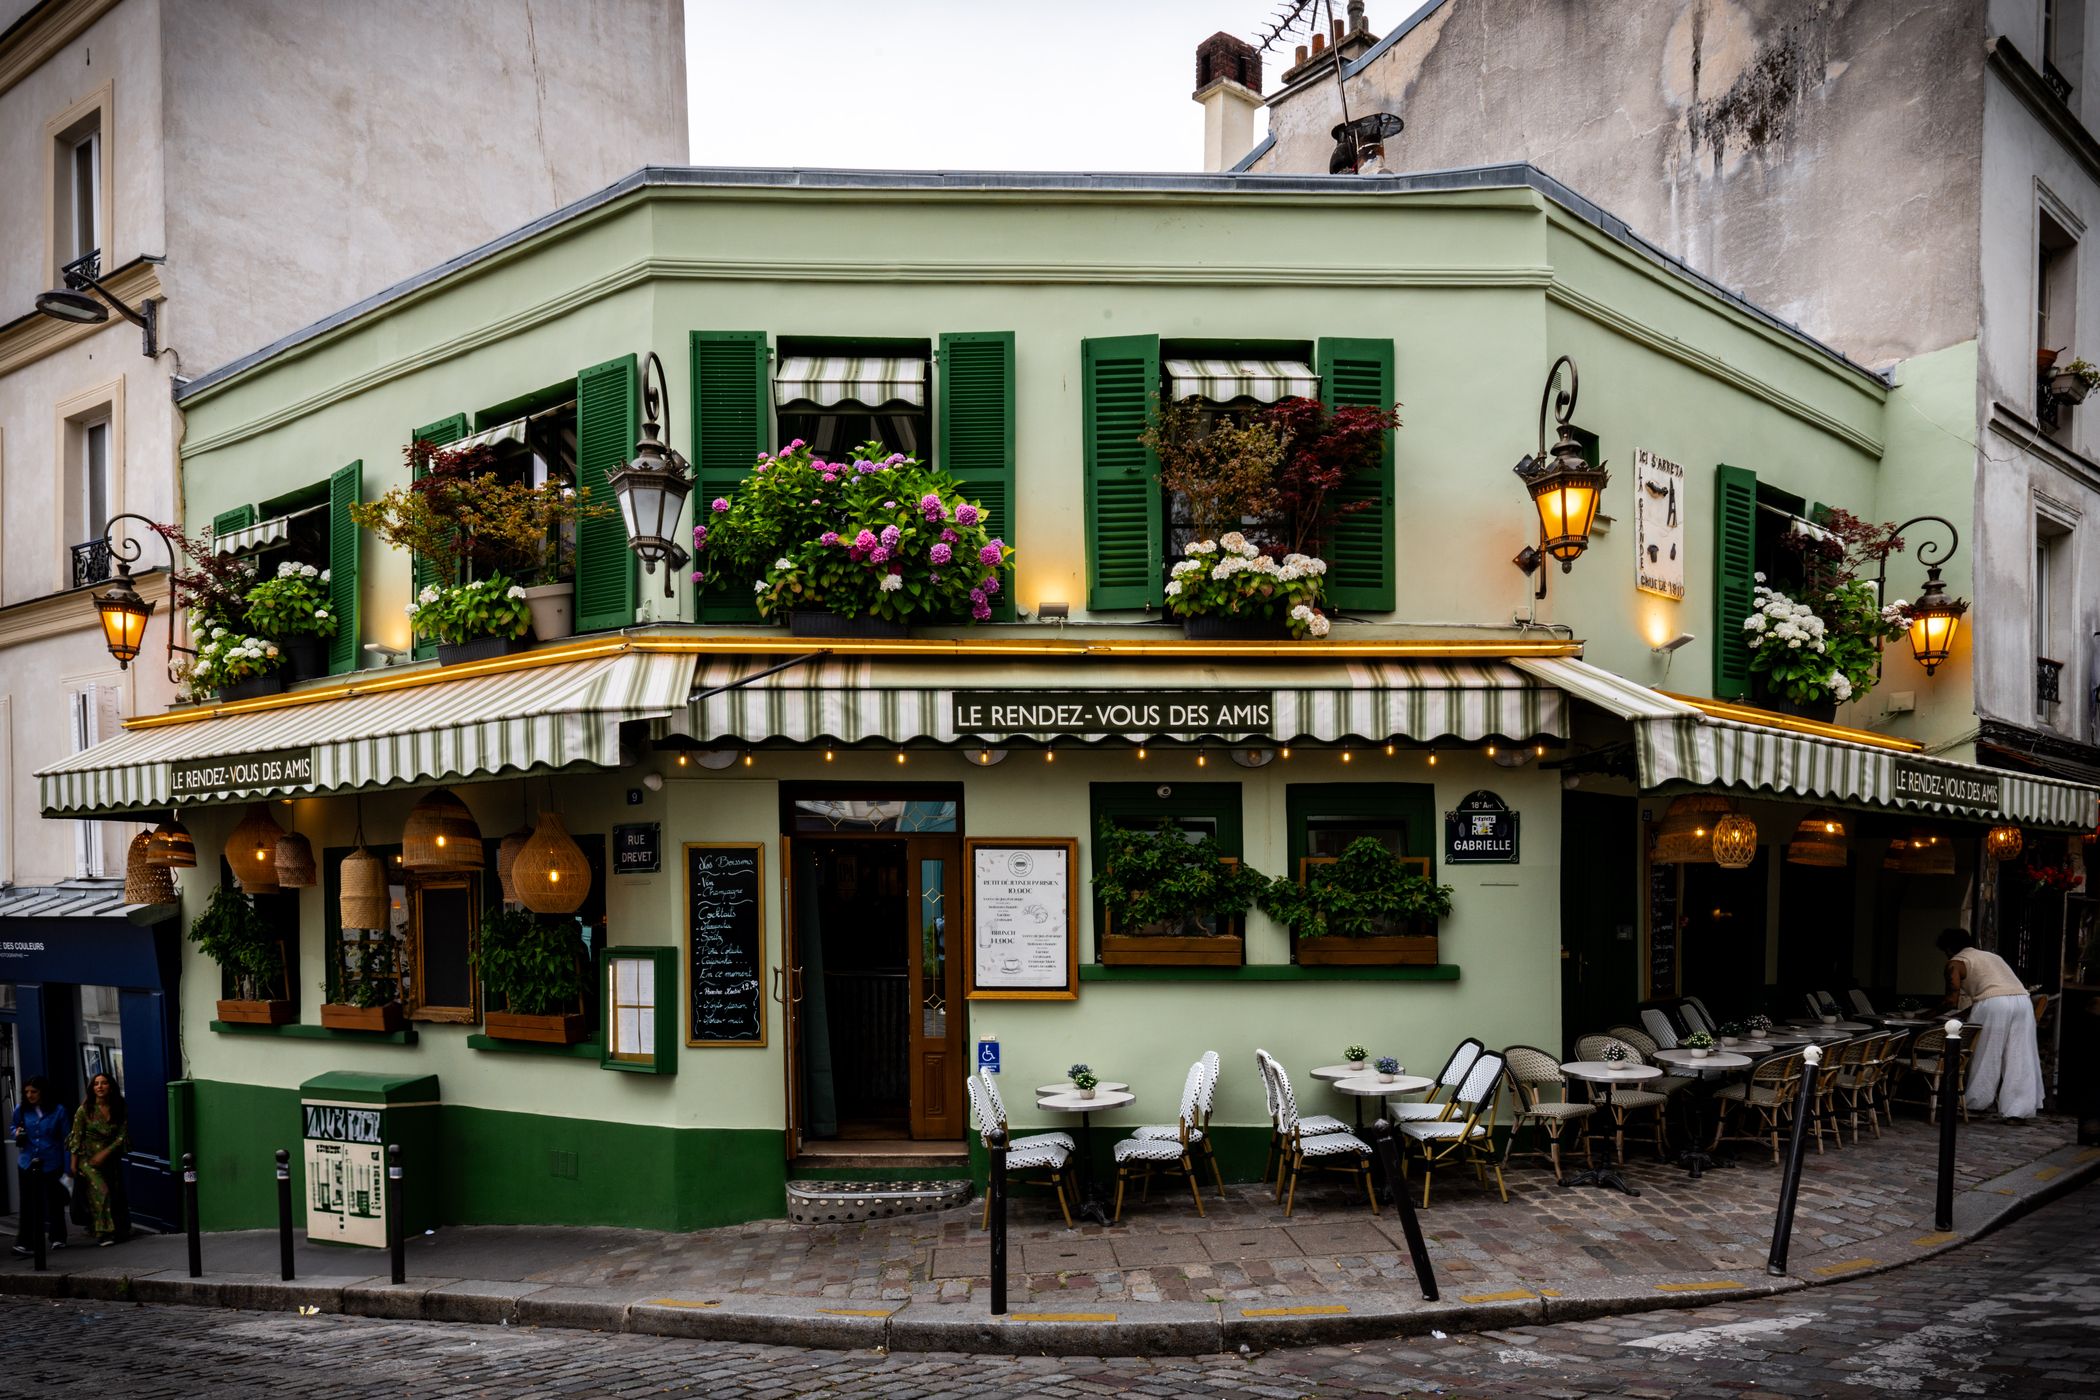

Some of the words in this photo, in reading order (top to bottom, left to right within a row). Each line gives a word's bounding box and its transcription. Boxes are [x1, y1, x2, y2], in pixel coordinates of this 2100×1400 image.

[1639, 449, 1648, 465] ICI
[1659, 580, 1667, 592] DE
[1669, 582, 1685, 599] 1910
[957, 705, 983, 727] LE
[991, 705, 1161, 727] RENDEZ-VOUS
[1169, 705, 1210, 726] DES
[1216, 704, 1270, 726] AMIS
[172, 771, 184, 790] LE
[186, 763, 260, 789] RENDEZ-VOUS
[262, 761, 282, 781] DES
[284, 757, 311, 780] AMIS
[1896, 769, 1907, 791] LE
[1908, 771, 1966, 799] RENDEZ-VOUS
[1967, 781, 1981, 801] DES
[1981, 784, 1999, 804] AMIS
[631, 792, 638, 802] 9
[1471, 824, 1494, 836] RE
[627, 834, 646, 846] RUE
[1453, 840, 1512, 851] GABRIELLE
[621, 851, 653, 864] DREVET
[698, 906, 737, 920] Cocktails
[2, 942, 14, 950] DES
[14, 942, 45, 951] COULEURS
